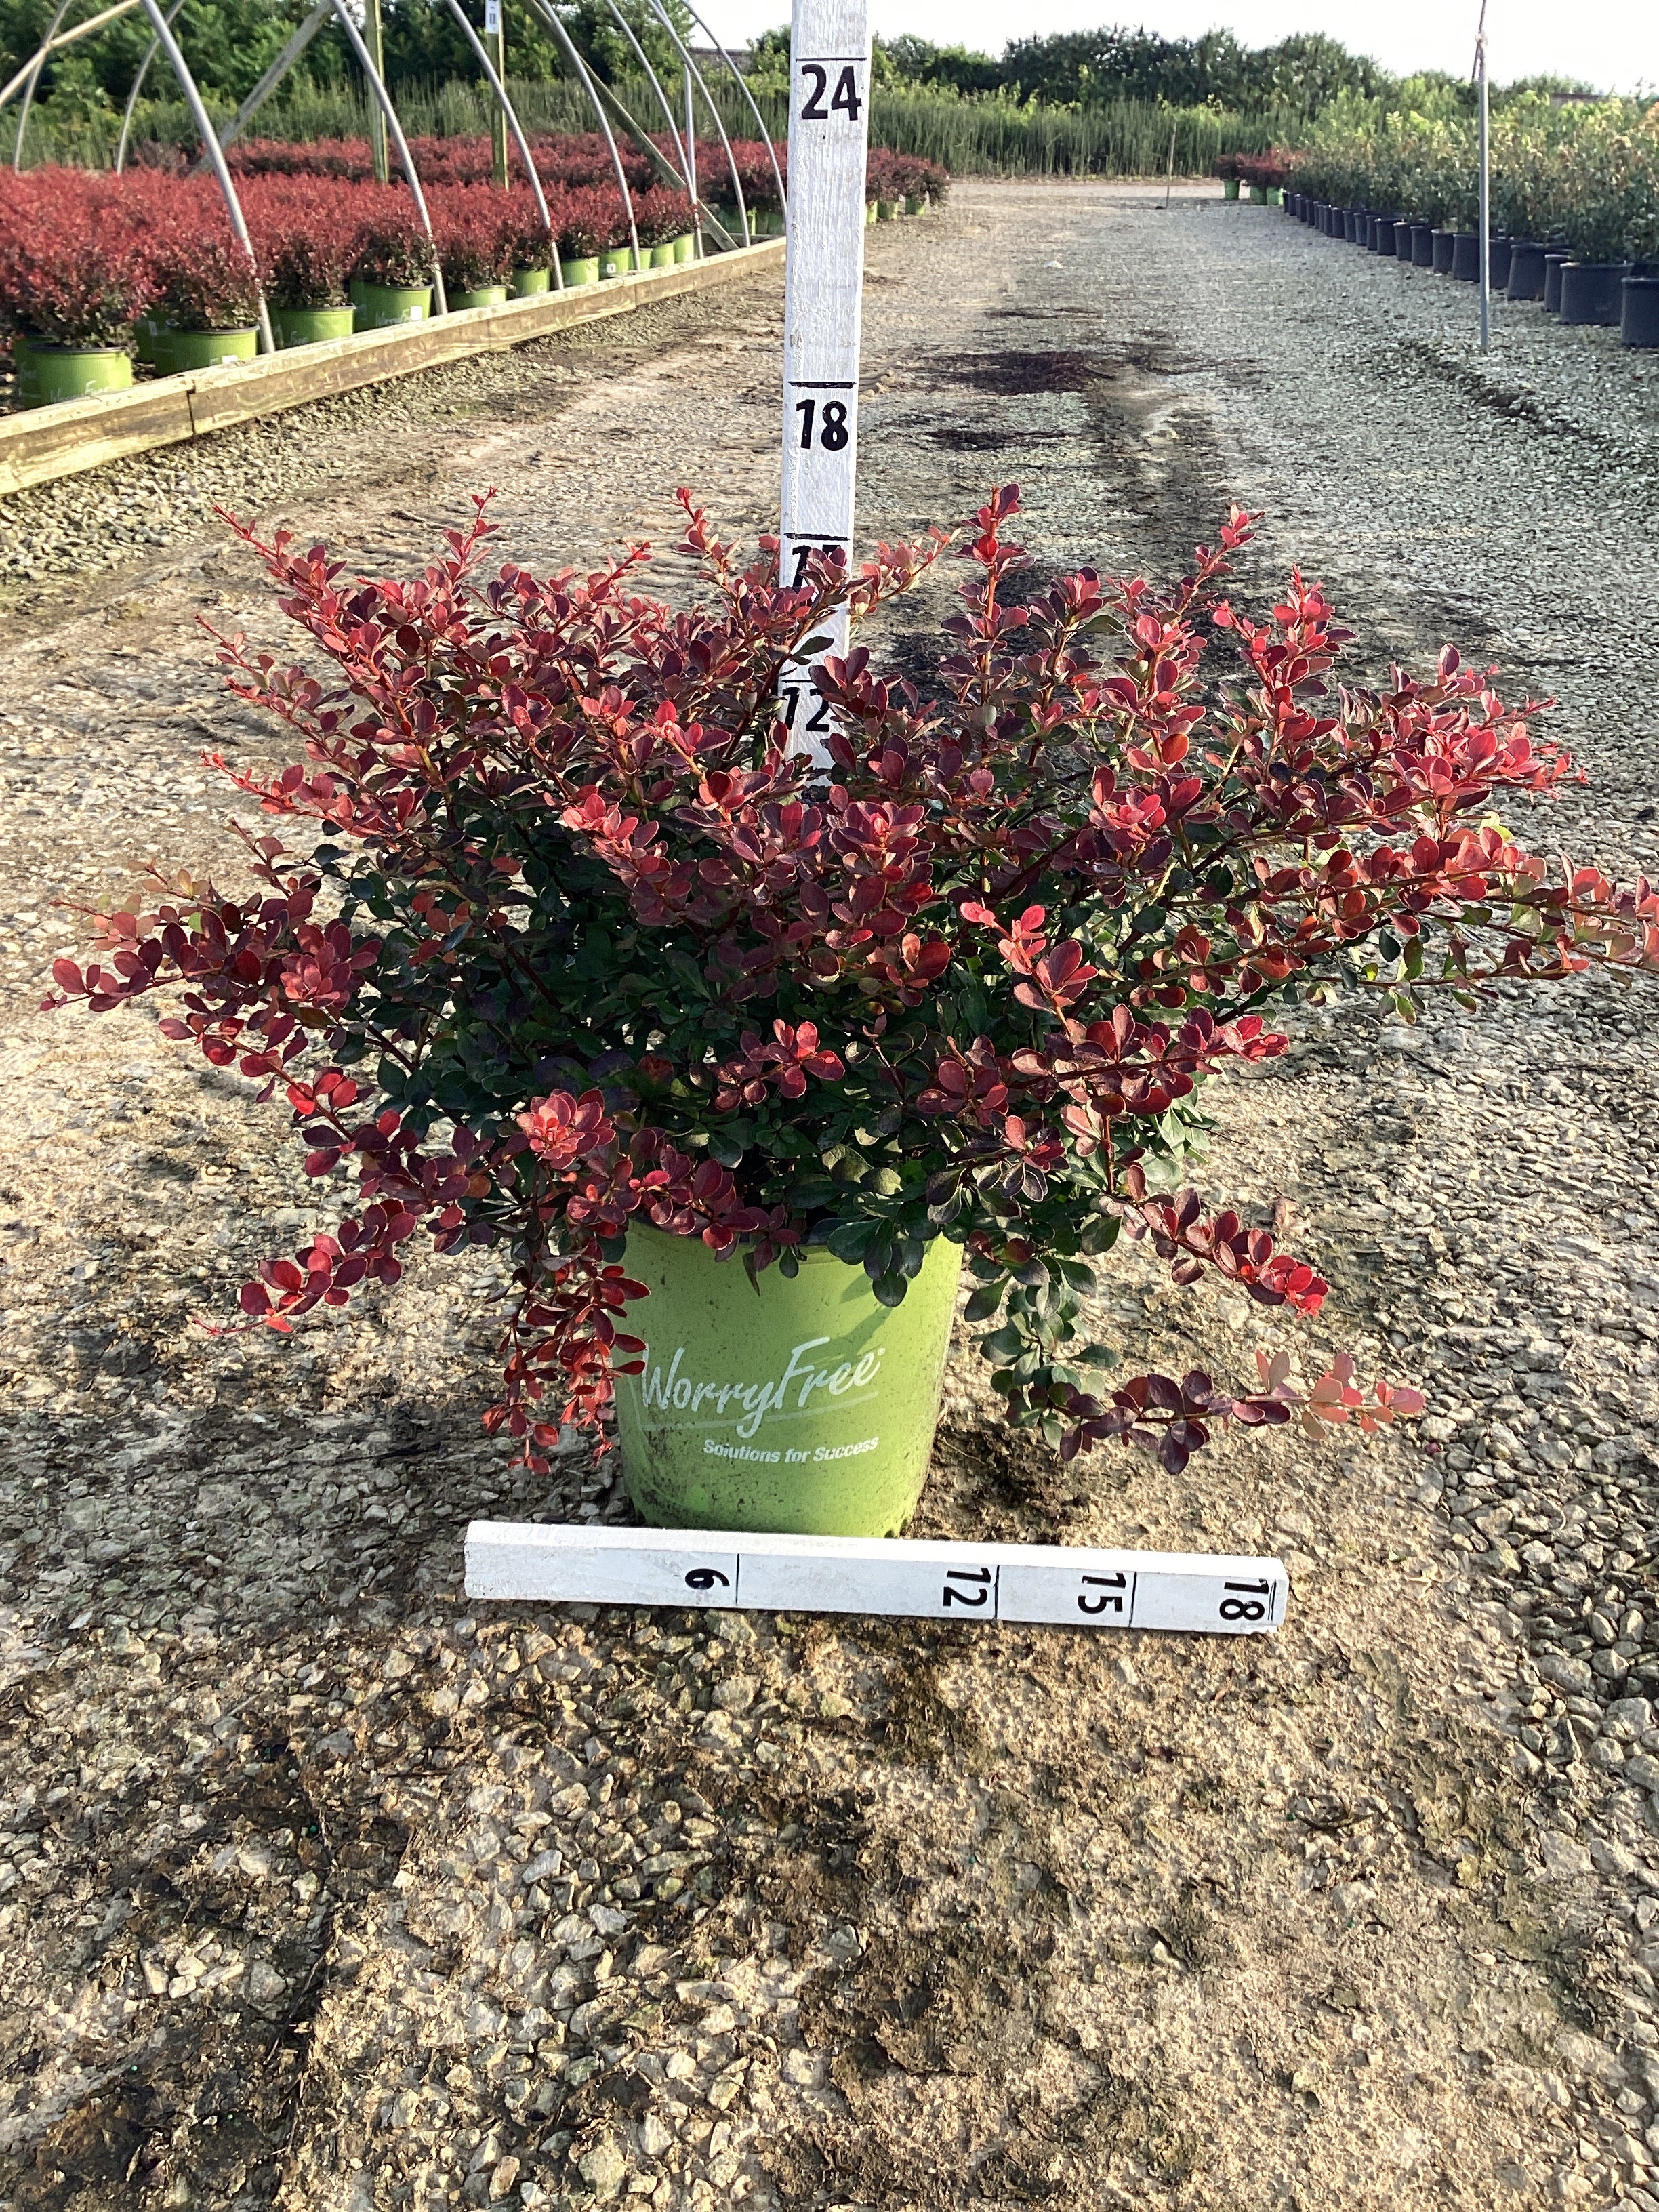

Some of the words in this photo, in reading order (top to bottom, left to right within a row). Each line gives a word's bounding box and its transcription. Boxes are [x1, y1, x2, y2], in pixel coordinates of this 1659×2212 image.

[801, 64, 862, 121] 24
[796, 399, 848, 451] 18
[782, 686, 830, 732] 12
[703, 1439, 781, 1463] Solutions
[785, 1448, 811, 1463] for
[813, 1437, 879, 1462] Success
[684, 1568, 730, 1590] 6
[943, 1568, 991, 1607] 12
[1078, 1572, 1126, 1614] 15
[1219, 1578, 1269, 1621] 18
